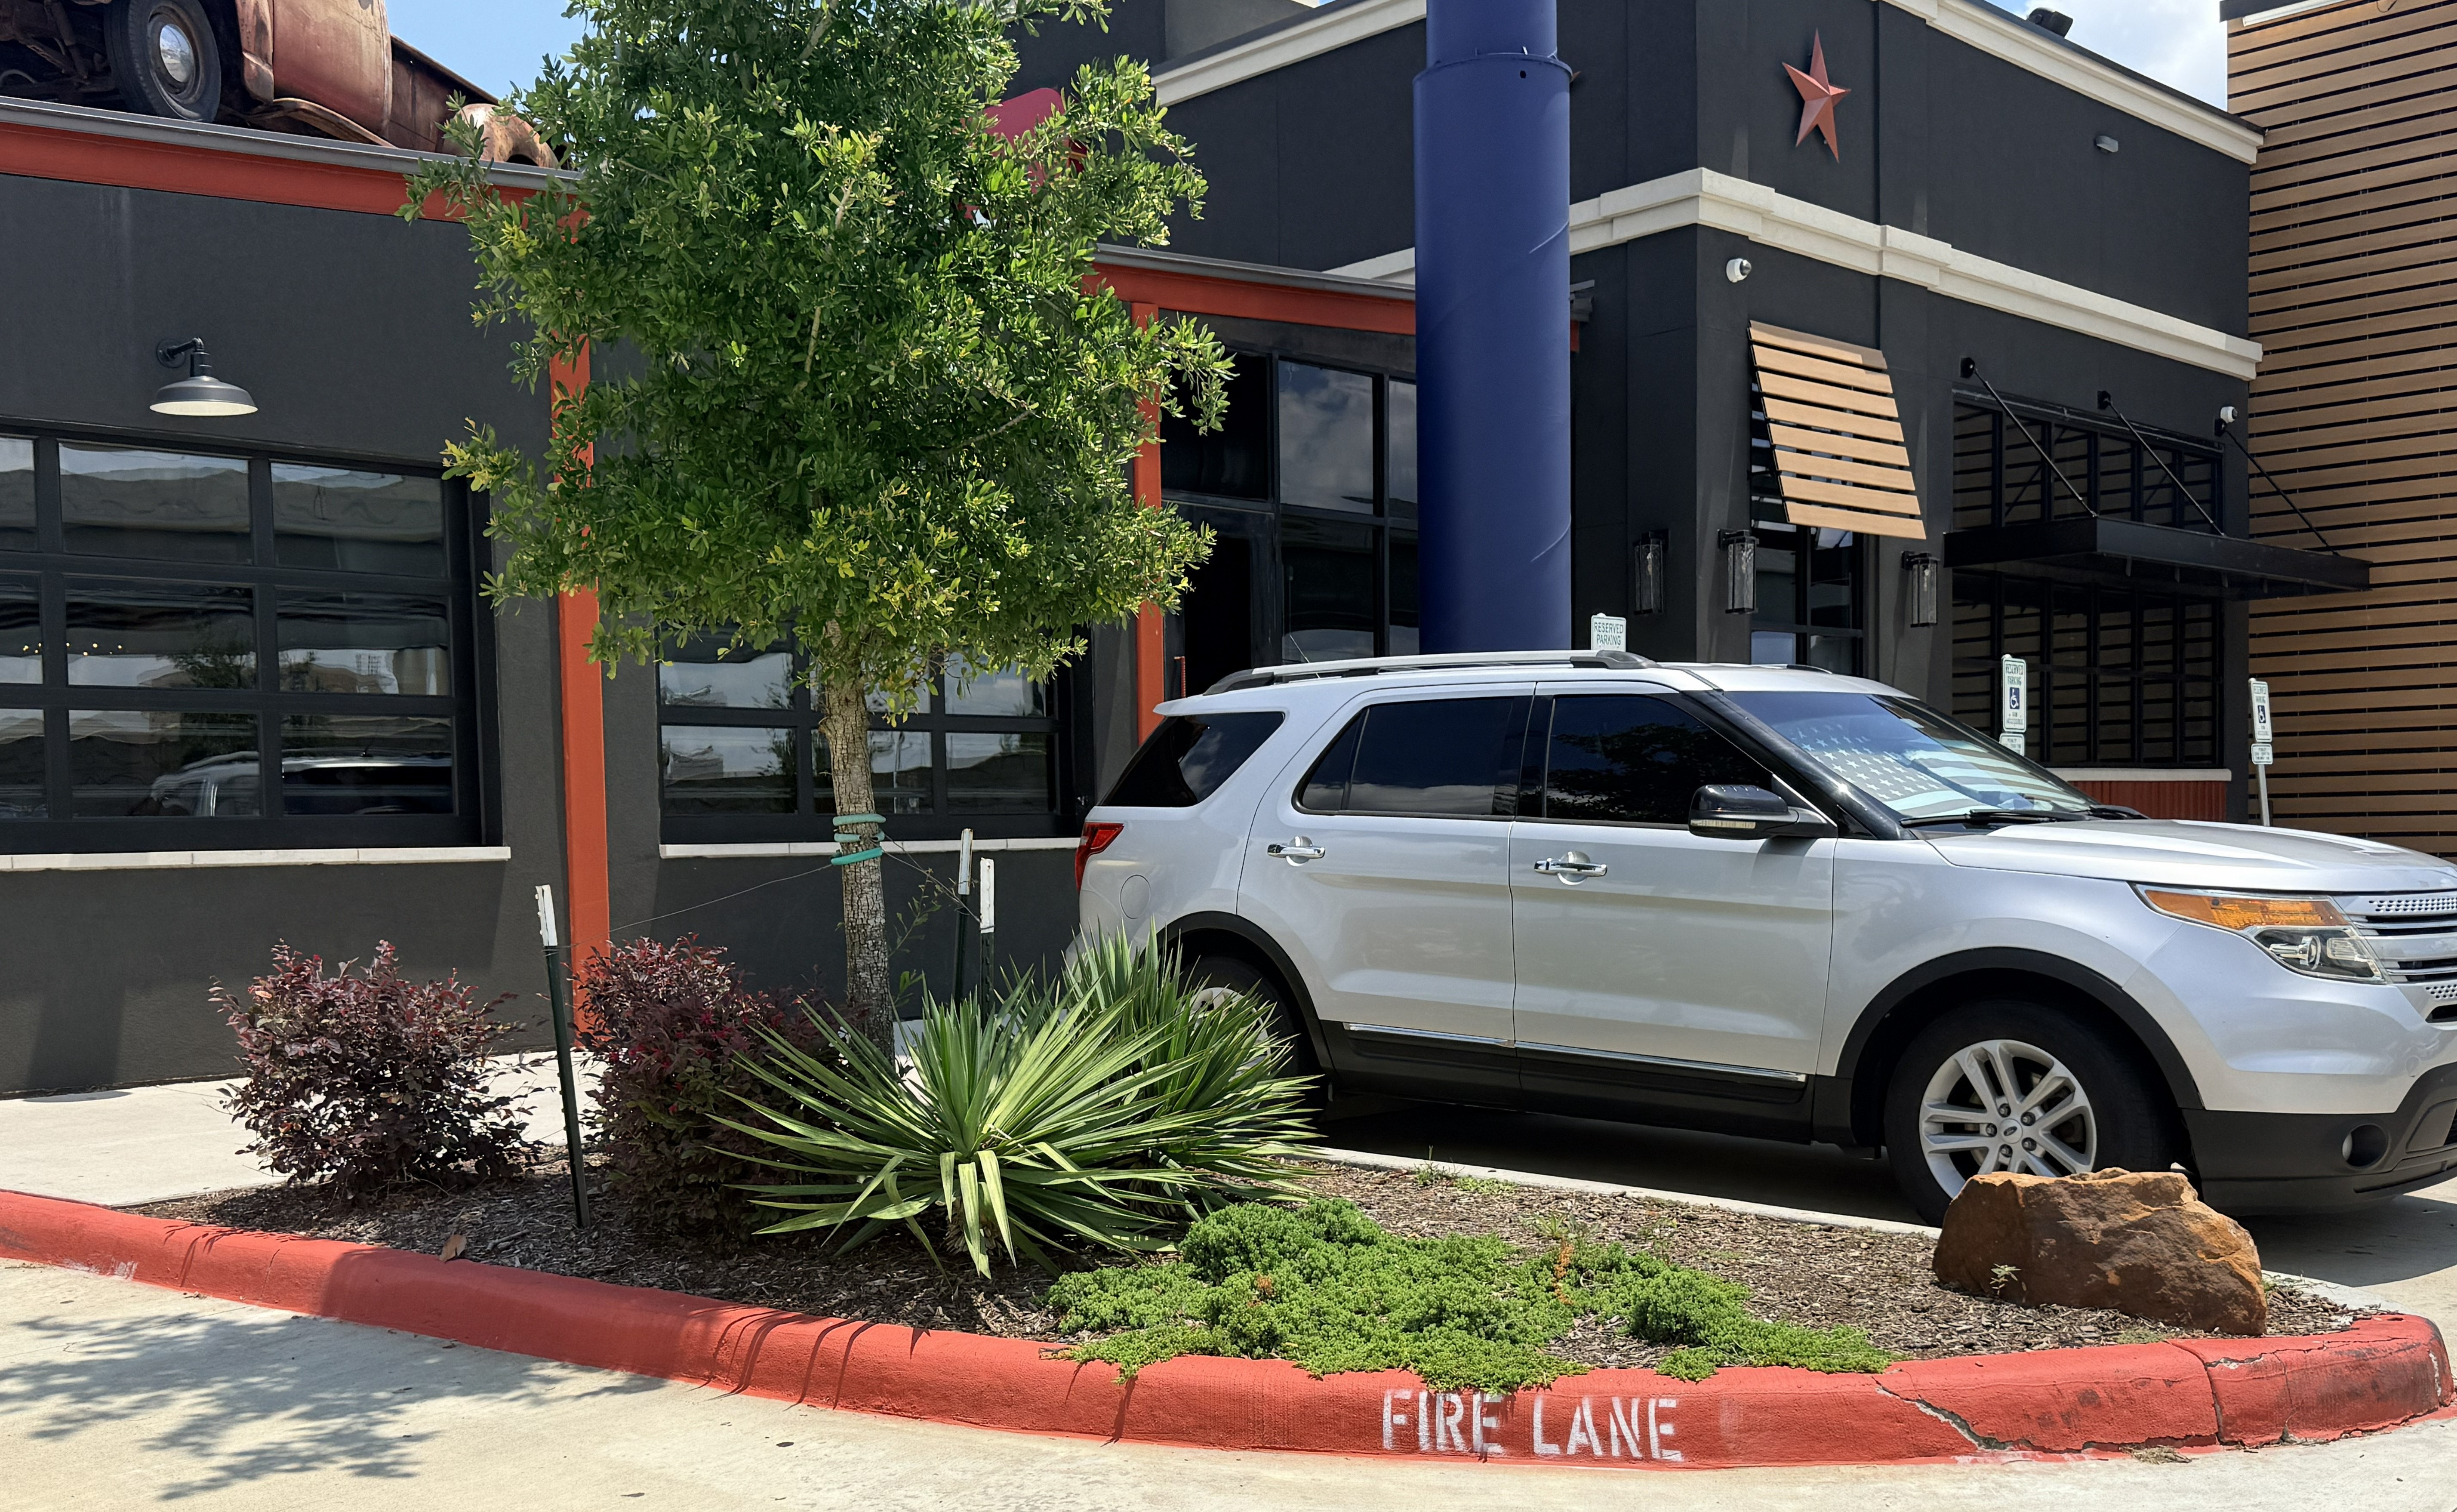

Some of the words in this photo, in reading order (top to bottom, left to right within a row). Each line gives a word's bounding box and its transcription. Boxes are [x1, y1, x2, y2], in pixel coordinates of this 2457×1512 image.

[1594, 622, 1623, 634] RESERVED
[1597, 634, 1621, 645] PARKING
[1382, 1389, 1505, 1454] FIRE
[1533, 1395, 1684, 1462] LANE
